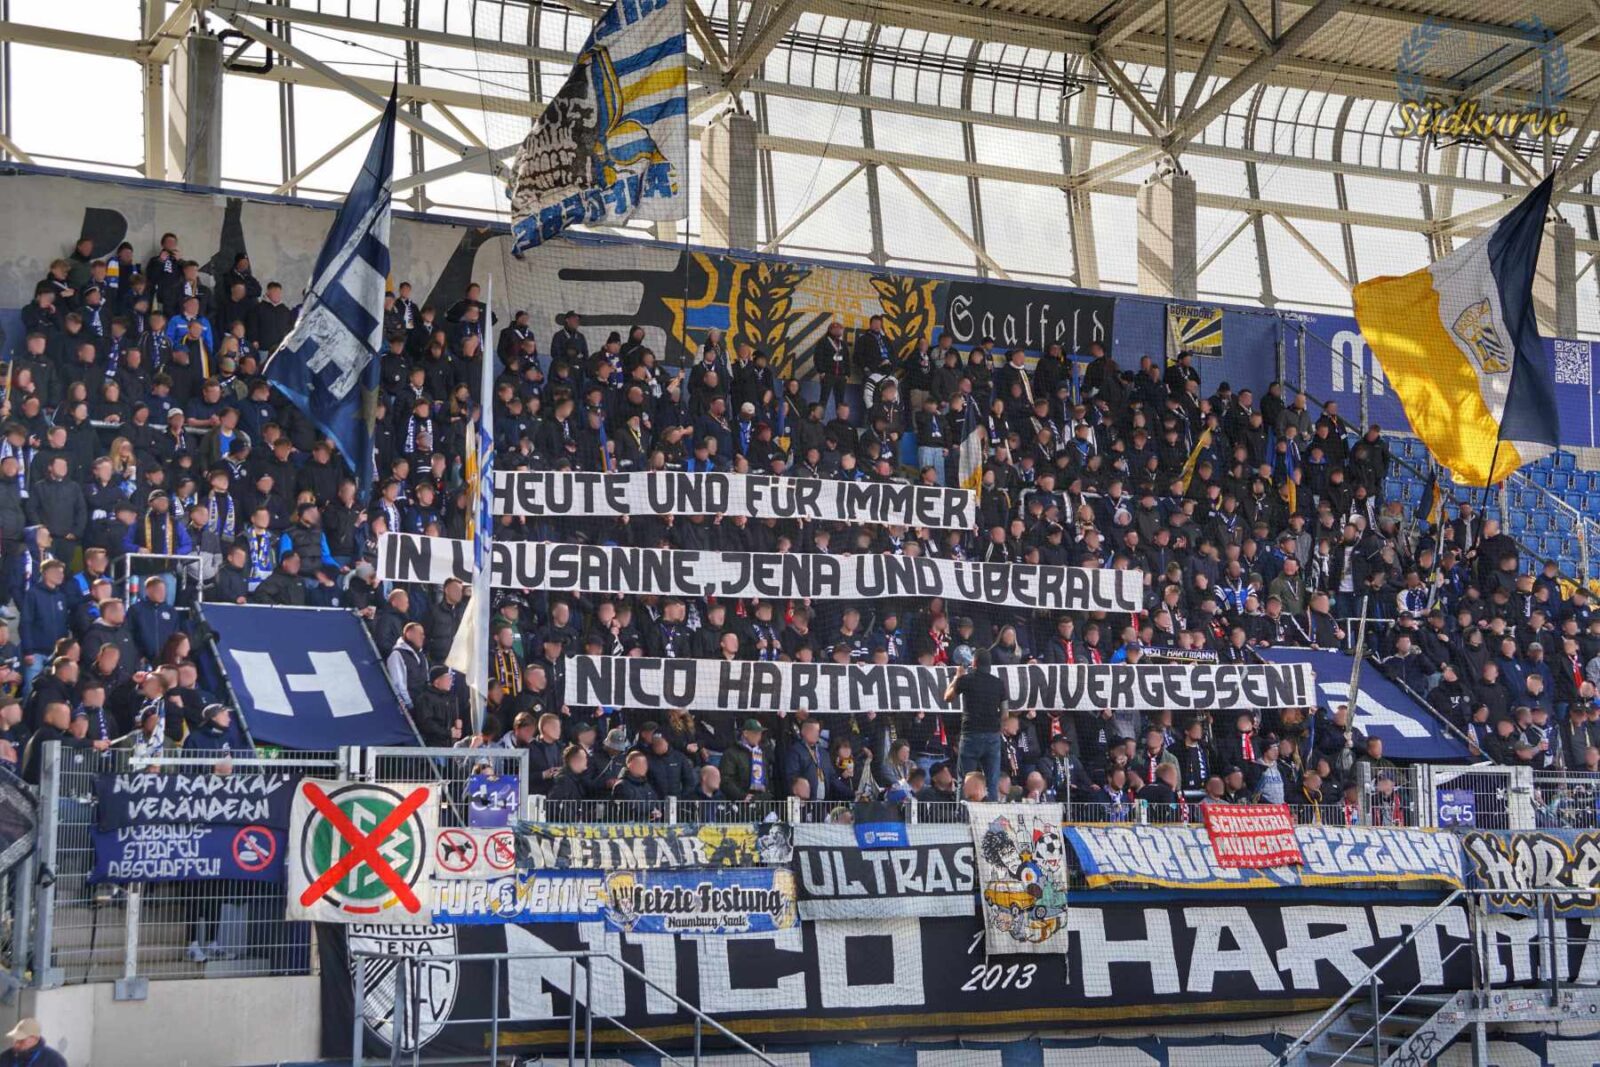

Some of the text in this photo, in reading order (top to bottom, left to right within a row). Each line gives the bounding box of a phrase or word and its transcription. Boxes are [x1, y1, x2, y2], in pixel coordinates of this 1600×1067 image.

[950, 293, 1105, 353] Saalfeld
[493, 471, 969, 528] HEUTE UND FÜR IMMER
[385, 533, 431, 581] IN
[721, 550, 841, 597] JENA
[856, 553, 943, 597] UND
[953, 561, 1137, 612] ÜBERALL
[229, 648, 374, 718] H
[577, 656, 697, 708] NICO
[997, 662, 1307, 711] UNVERGESSEN!
[113, 773, 283, 796] NOFV RADIKAL
[128, 796, 270, 821] VERÄNDERN
[1440, 804, 1473, 821] C15
[117, 823, 213, 841] VERBANDS-
[1209, 814, 1292, 833] SCHICKERIA
[123, 840, 200, 860] STRAFEN
[527, 837, 710, 869] WEIMAR
[1214, 832, 1300, 857] MÜNCHEN
[108, 858, 221, 879] ABSCHAFFEN!
[799, 847, 974, 896] ULTRAS
[633, 883, 784, 916] Letzte Festung
[375, 941, 434, 956] JENA
[506, 918, 926, 1020] NICO
[960, 963, 1038, 991] 2013
